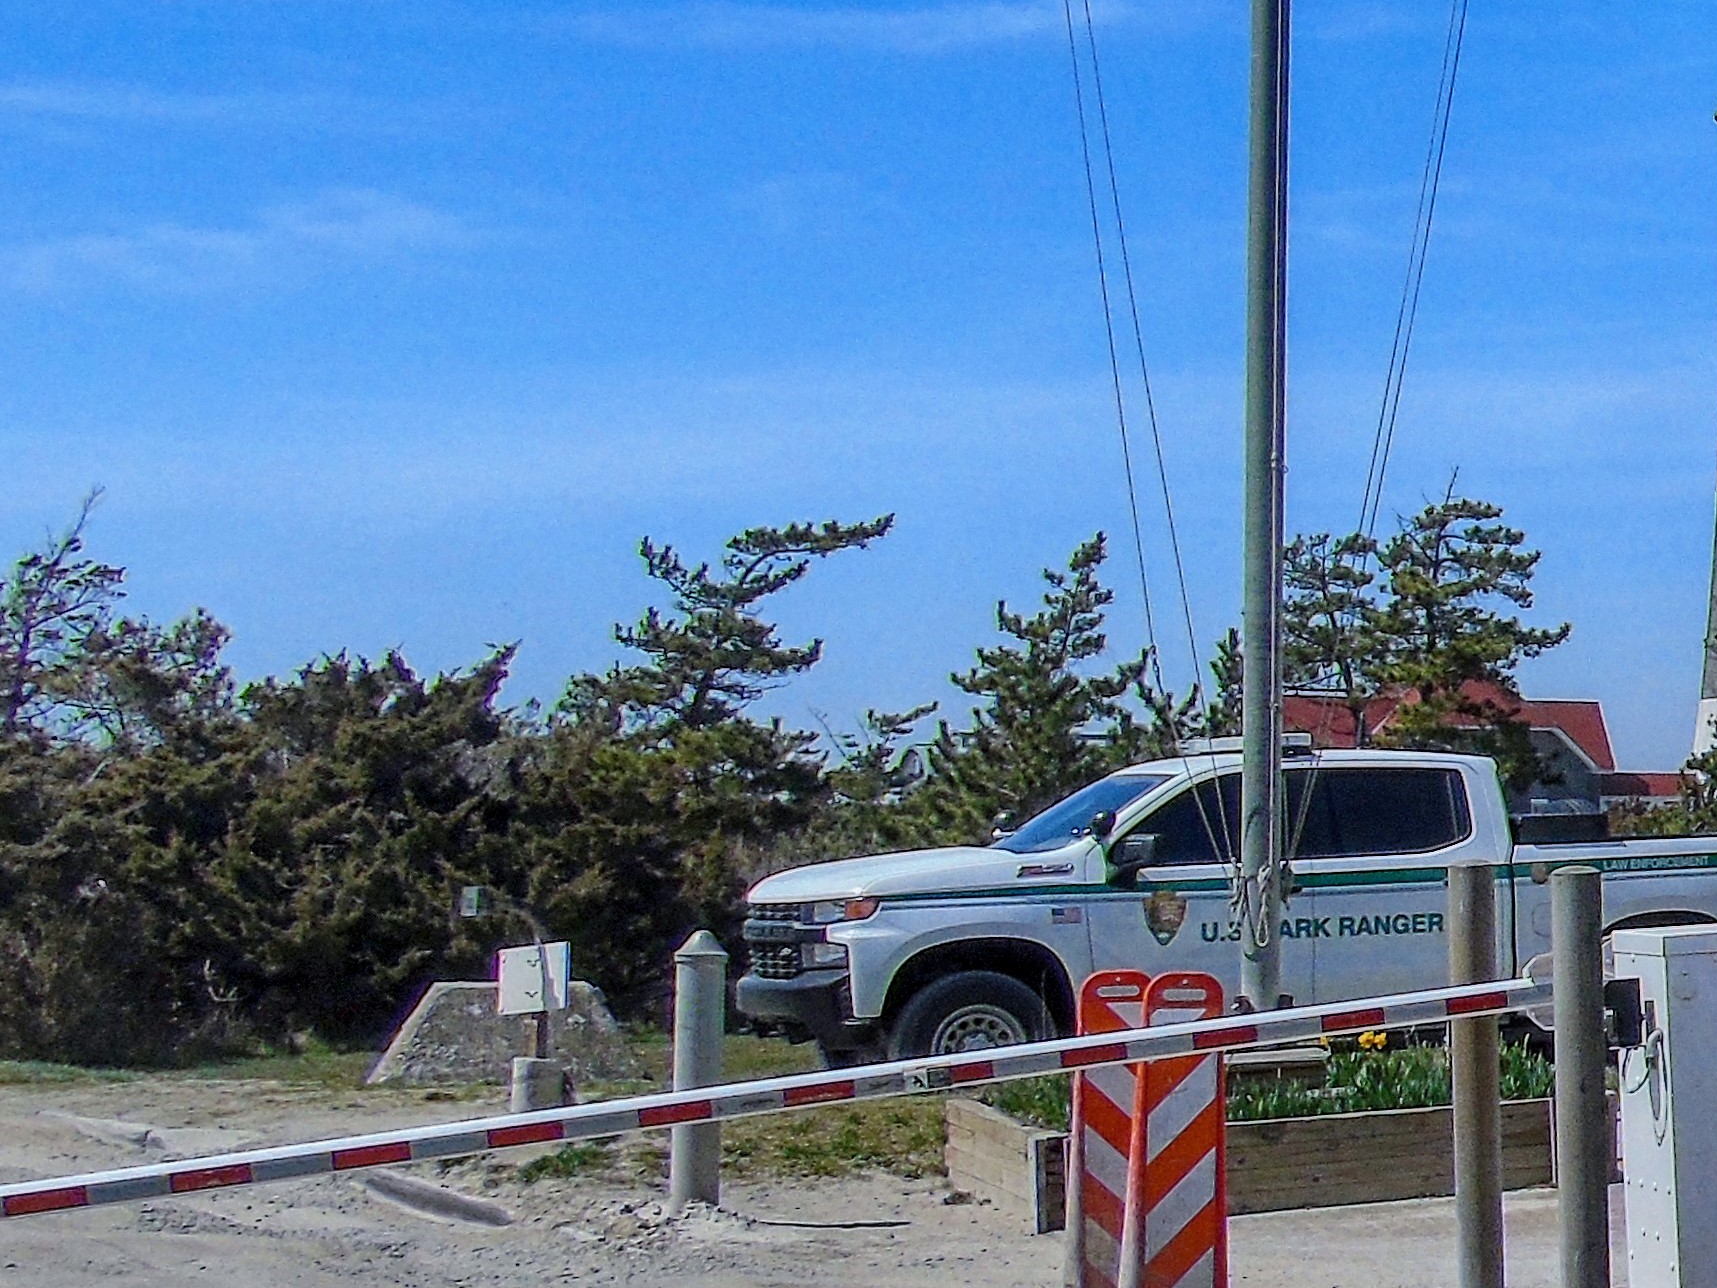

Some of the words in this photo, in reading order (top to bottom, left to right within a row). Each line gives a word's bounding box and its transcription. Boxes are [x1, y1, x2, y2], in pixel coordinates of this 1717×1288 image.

[1603, 859, 1629, 870] LAW
[1201, 922, 1242, 942] U.S
[1279, 916, 1332, 939] ARK
[1338, 912, 1444, 937] RANGER
